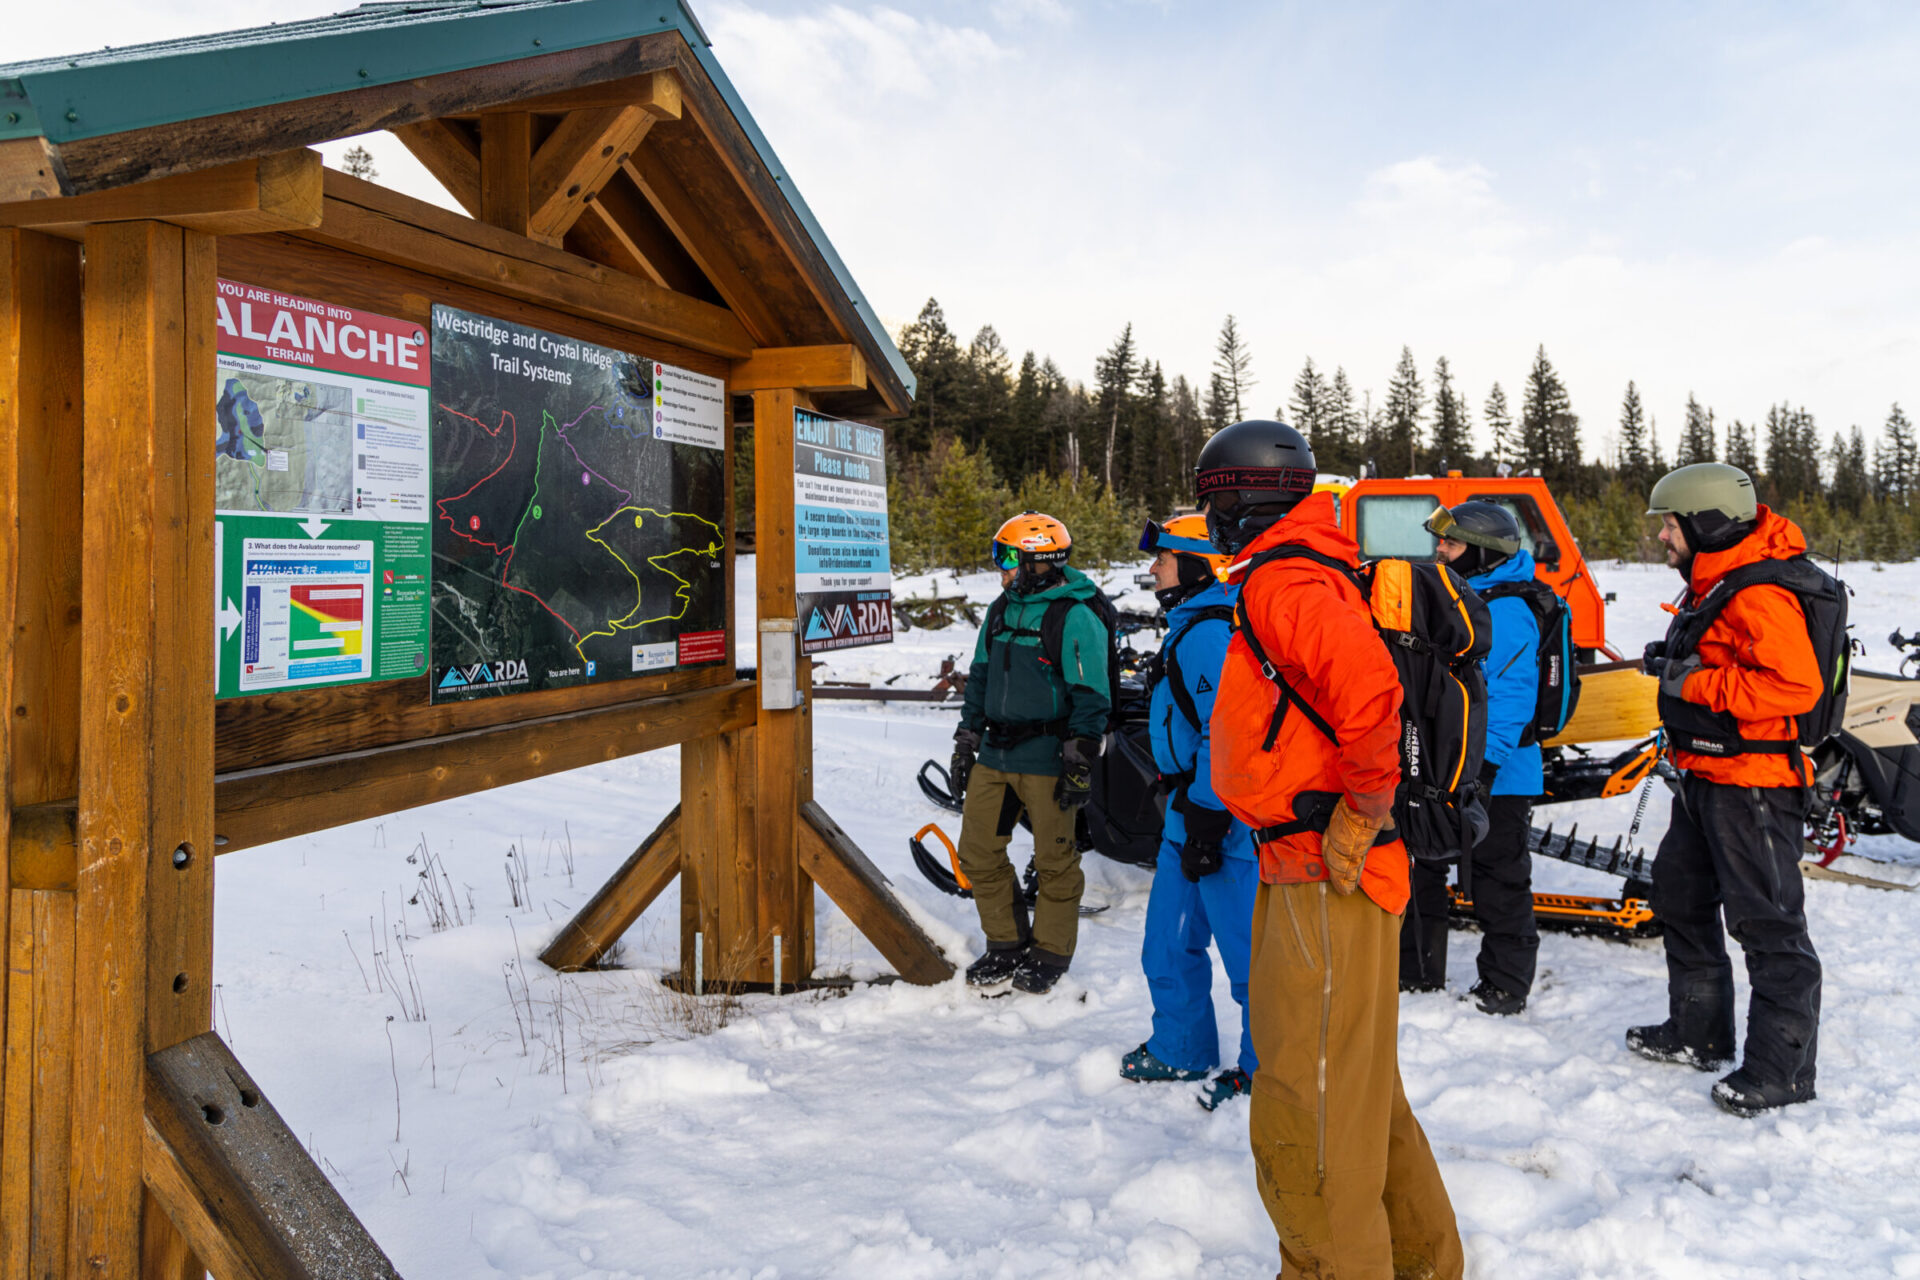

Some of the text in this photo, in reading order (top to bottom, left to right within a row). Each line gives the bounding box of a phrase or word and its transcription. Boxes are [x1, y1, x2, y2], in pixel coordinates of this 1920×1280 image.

[218, 282, 352, 321] YOU ARE HEADING INTO
[216, 296, 419, 370] ALANCHE
[436, 310, 612, 370] Westridge and Crystal Ridge
[264, 346, 314, 364] TERRAIN
[218, 358, 262, 371] heading into?
[490, 353, 572, 386] Trail Systems
[796, 412, 882, 456] ENJOY THE RIDE?
[814, 452, 870, 480] Please donate
[1200, 473, 1236, 489] SMITH
[805, 510, 808, 521] A
[810, 512, 825, 522] secure
[827, 512, 845, 524] donation
[808, 525, 819, 537] large
[821, 527, 830, 538] sign
[808, 545, 831, 556] Donations
[832, 548, 840, 556] can
[875, 547, 880, 557] to
[1034, 552, 1066, 560] SMITH
[820, 577, 832, 586] Thank
[848, 578, 856, 587] your
[549, 670, 558, 678] You
[568, 668, 580, 676] here
[588, 662, 595, 676] P
